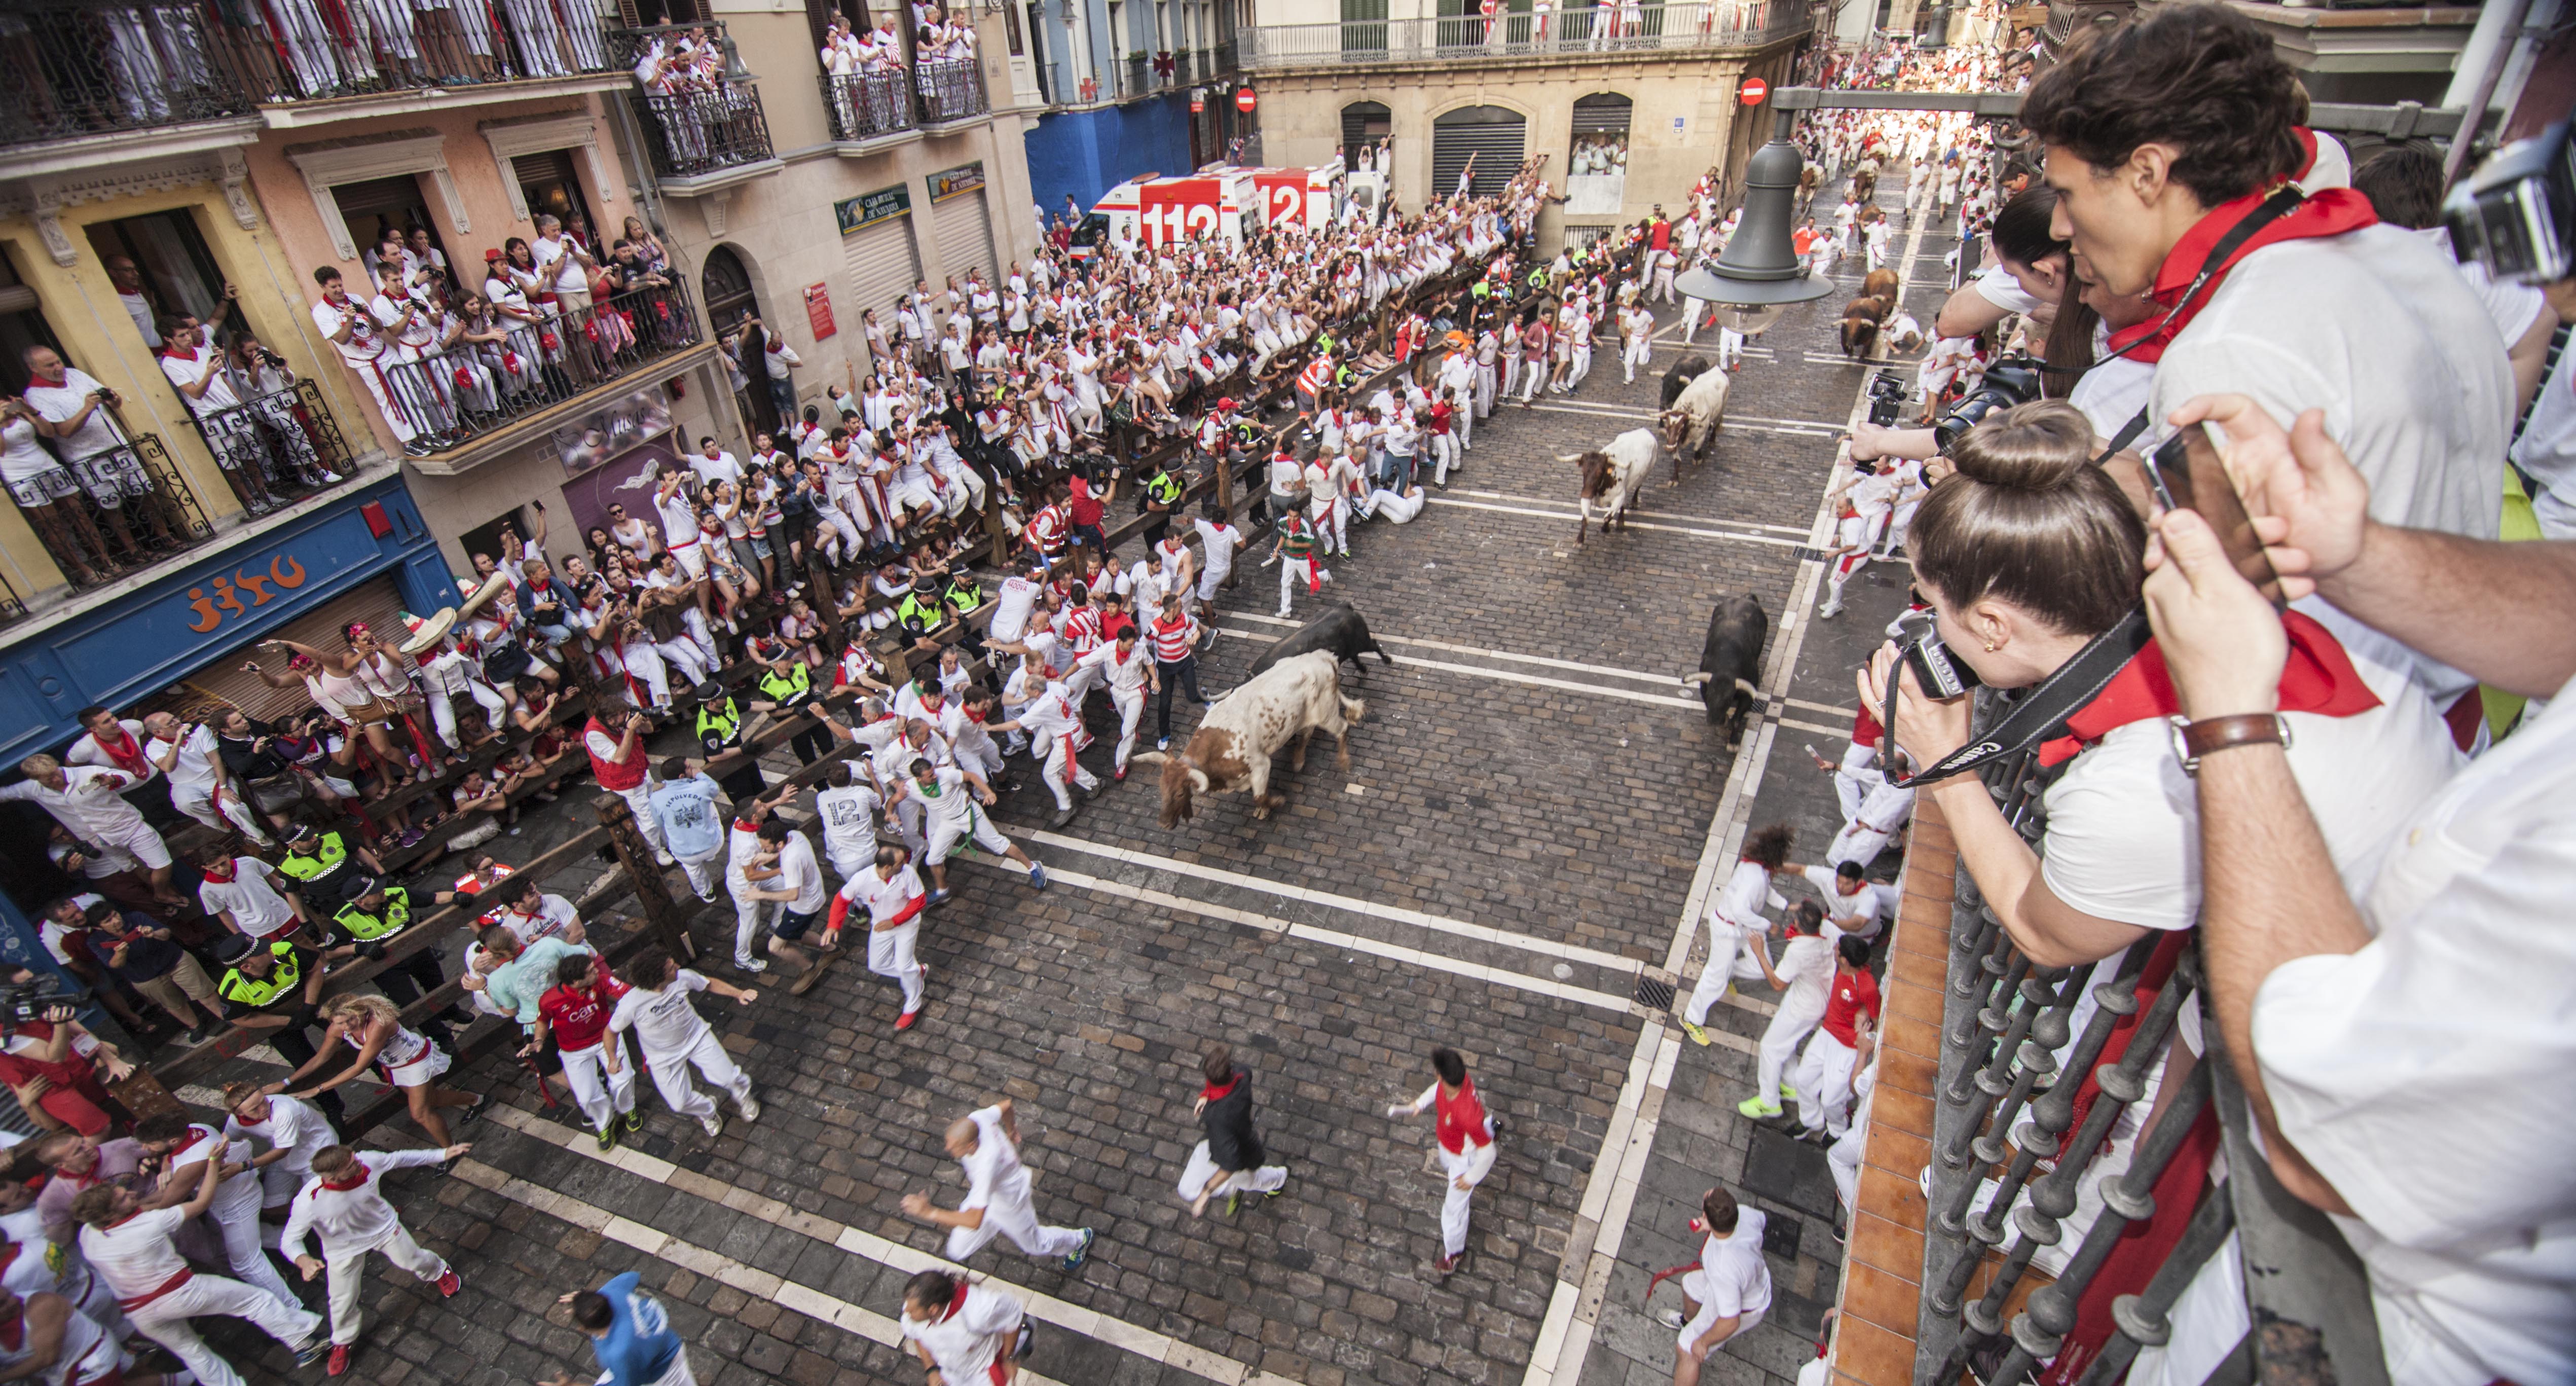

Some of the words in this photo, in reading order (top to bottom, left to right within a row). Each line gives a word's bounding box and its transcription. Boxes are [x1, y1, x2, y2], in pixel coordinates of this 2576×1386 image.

[951, 183, 959, 192] DE
[867, 209, 876, 219] DE
[1143, 204, 1218, 256] 112
[1940, 742, 2002, 769] Canon
[569, 1003, 599, 1023] can
